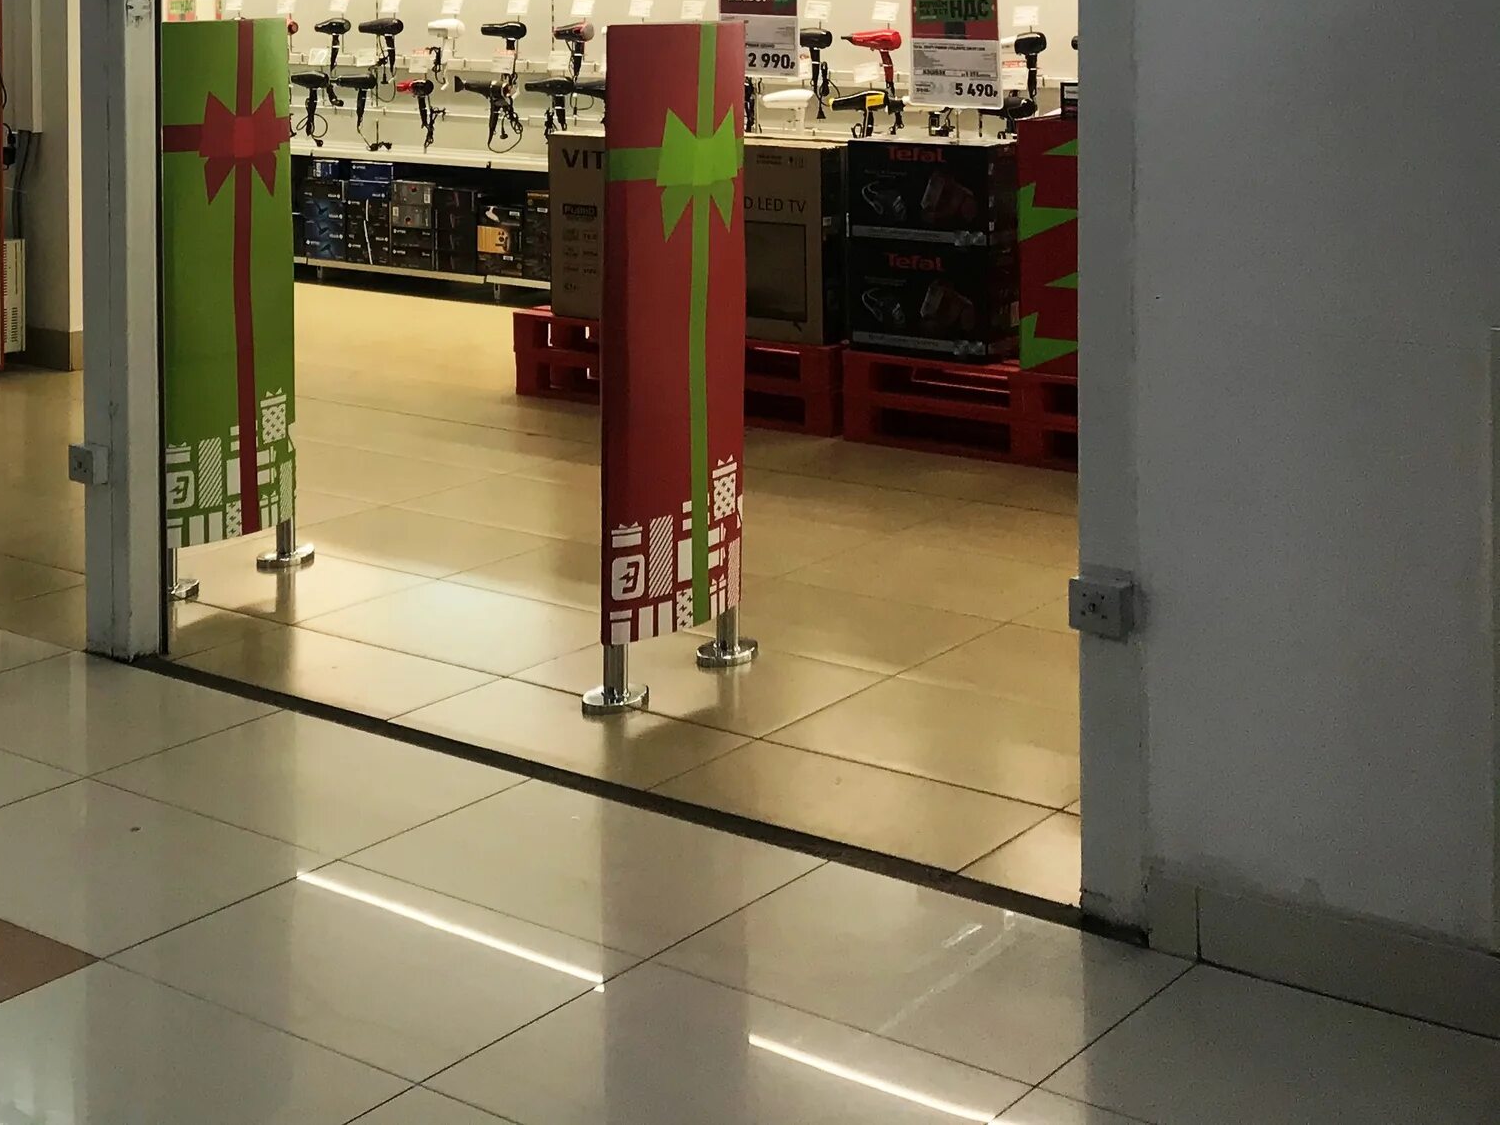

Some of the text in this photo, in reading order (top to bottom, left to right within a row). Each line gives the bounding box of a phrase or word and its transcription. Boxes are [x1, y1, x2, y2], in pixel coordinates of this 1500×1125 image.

[949, 0, 989, 21] НДС
[748, 52, 757, 68] 2
[955, 82, 963, 96] 5
[562, 148, 605, 170] VIT
[887, 146, 947, 163] Tefal
[758, 197, 783, 211] LED
[789, 198, 807, 213] TV
[886, 252, 945, 272] Tefal
